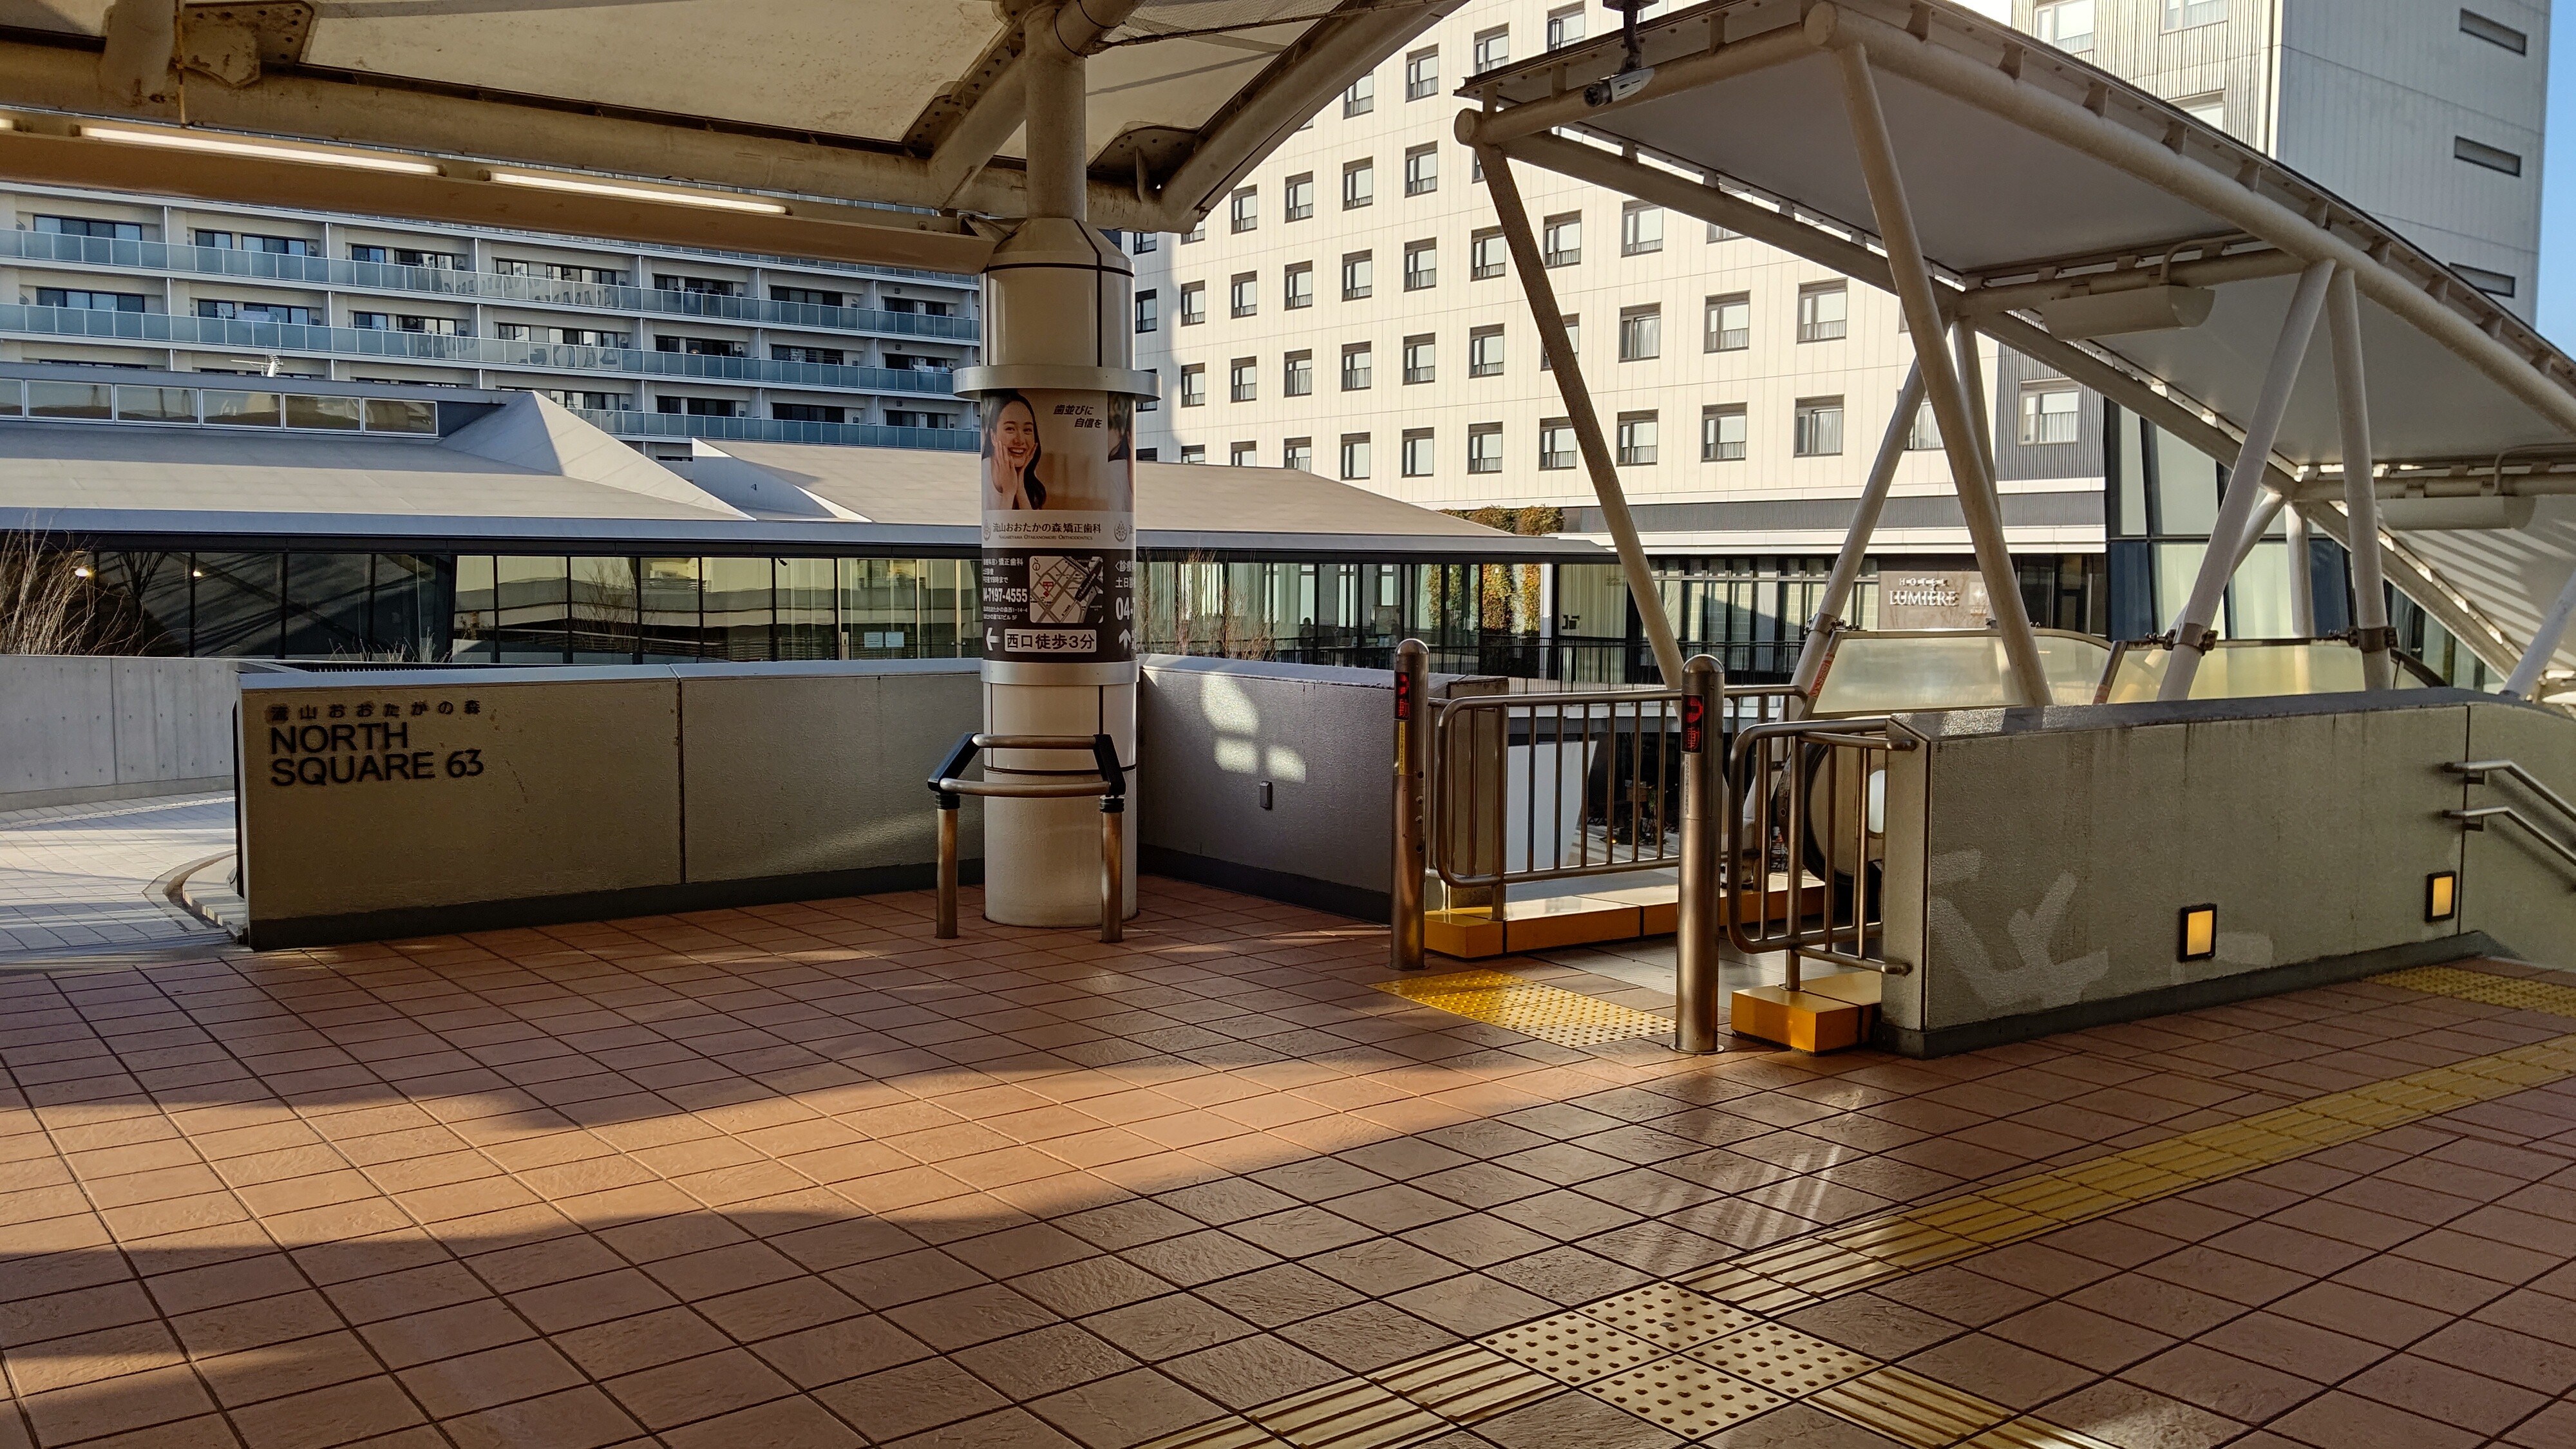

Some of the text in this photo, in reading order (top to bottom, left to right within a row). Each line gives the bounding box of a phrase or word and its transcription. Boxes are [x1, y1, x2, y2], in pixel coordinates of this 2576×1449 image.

[1053, 404, 1094, 415] 歯並びに
[1074, 417, 1103, 428] 自信を
[1899, 577, 1946, 587] HOTEL
[1007, 633, 1095, 650] 西口徒歩3分
[270, 699, 481, 721] 流山おおたかの森
[271, 722, 408, 754] NORTH
[271, 749, 484, 786] SQUARE 63
